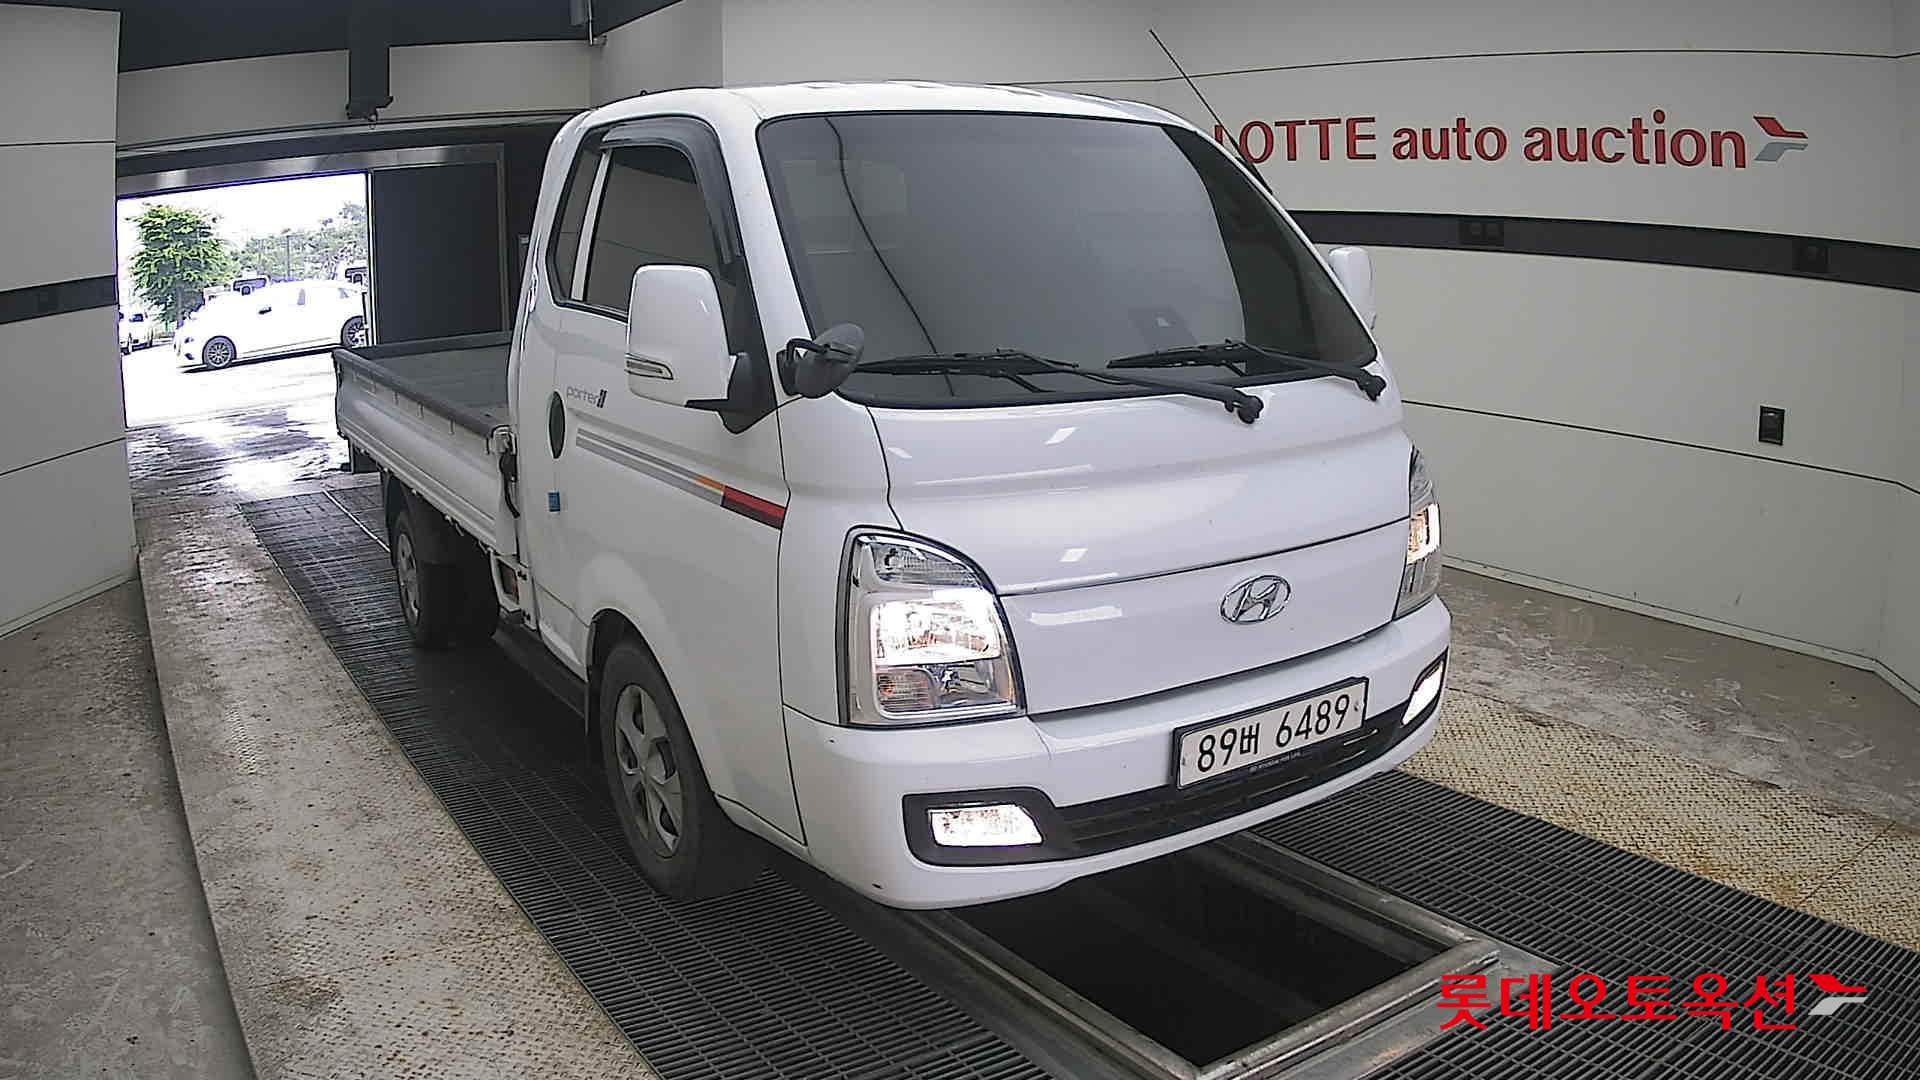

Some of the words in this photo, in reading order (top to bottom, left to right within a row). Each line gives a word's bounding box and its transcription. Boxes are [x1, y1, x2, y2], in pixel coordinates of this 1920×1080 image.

[1392, 117, 1508, 161] auto
[1523, 109, 1747, 168] auction
[1197, 722, 1261, 773] 89버
[1275, 694, 1350, 748] 6489
